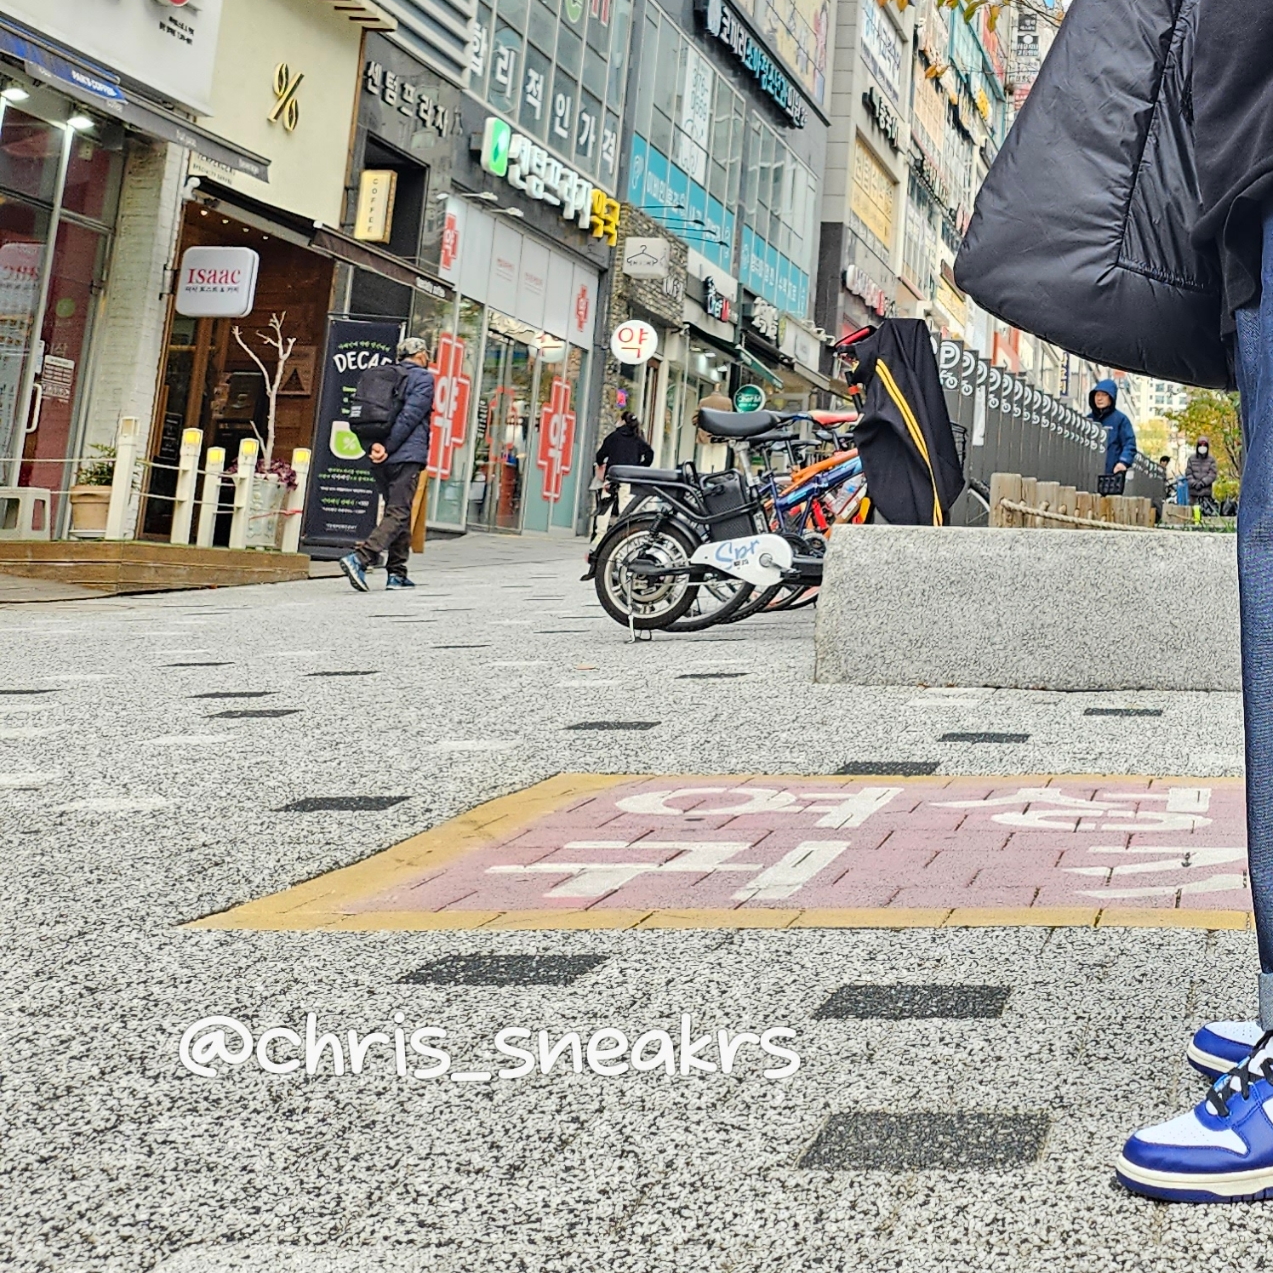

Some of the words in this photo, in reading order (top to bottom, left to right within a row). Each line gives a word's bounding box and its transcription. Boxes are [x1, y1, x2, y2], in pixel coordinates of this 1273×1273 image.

[366, 59, 451, 139] 센텀프라자
[367, 177, 379, 235] COFFEE
[618, 327, 650, 359] 약
